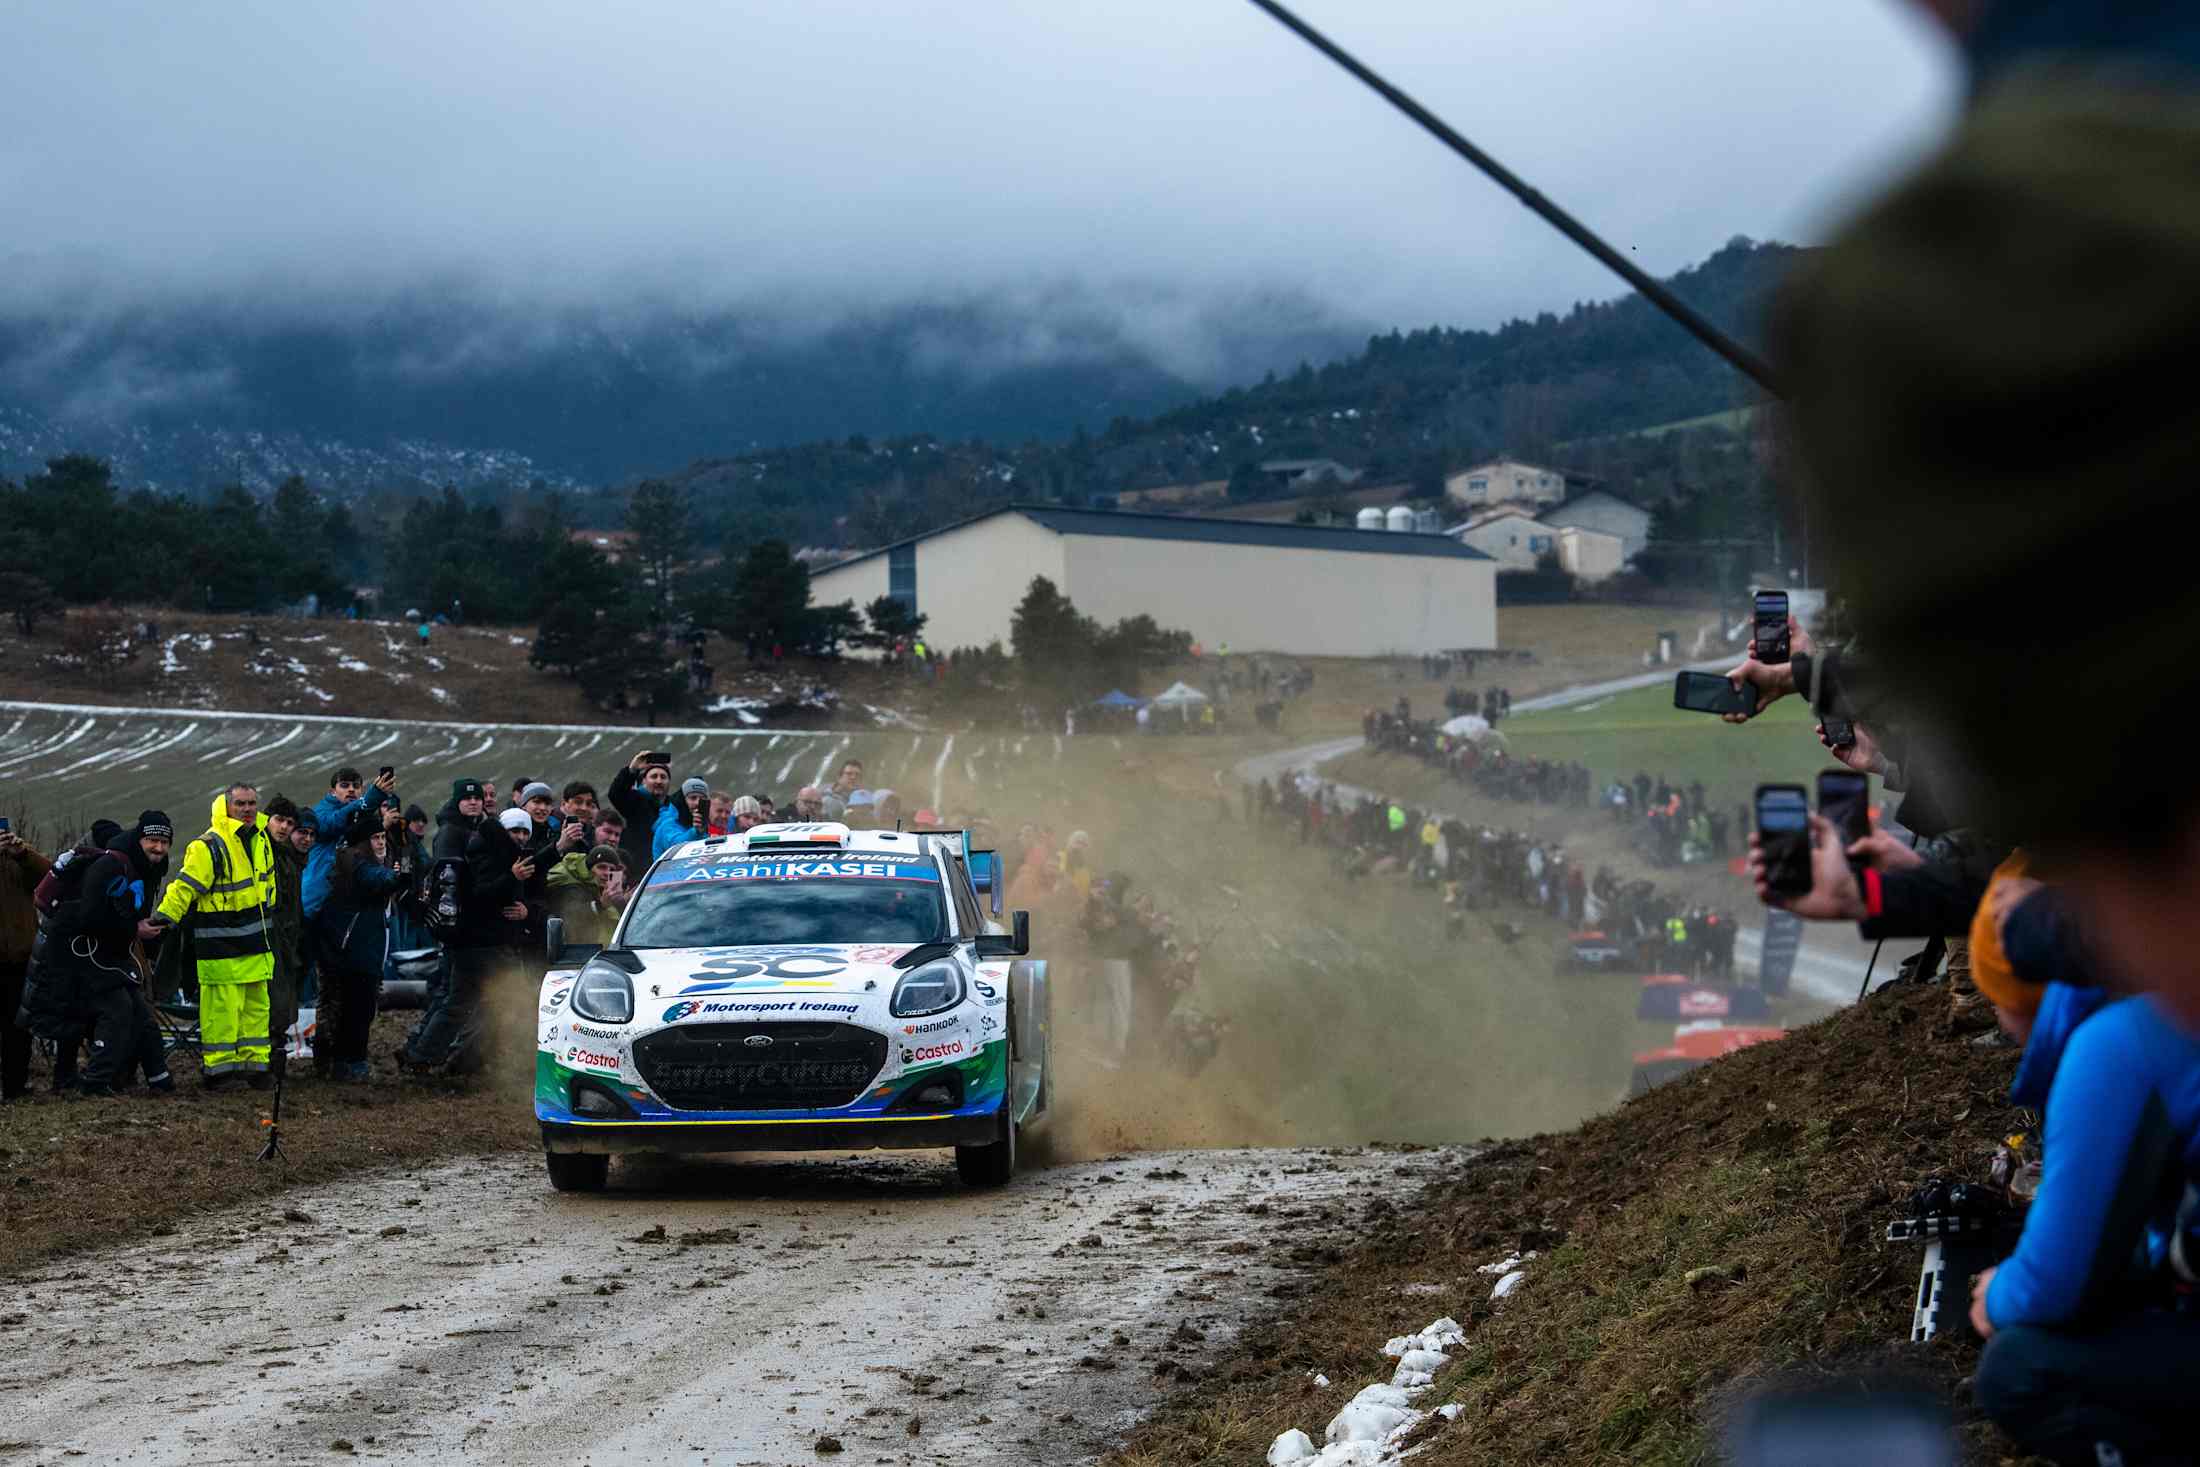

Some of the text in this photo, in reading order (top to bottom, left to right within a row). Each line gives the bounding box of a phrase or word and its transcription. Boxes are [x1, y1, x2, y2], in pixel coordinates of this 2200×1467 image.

[717, 853, 919, 865] Motorsport Ireland
[689, 954, 849, 981] SC
[702, 1001, 860, 1014] Motorsport Ireland
[577, 1050, 620, 1069] Castrol
[915, 1040, 964, 1061] Castrol
